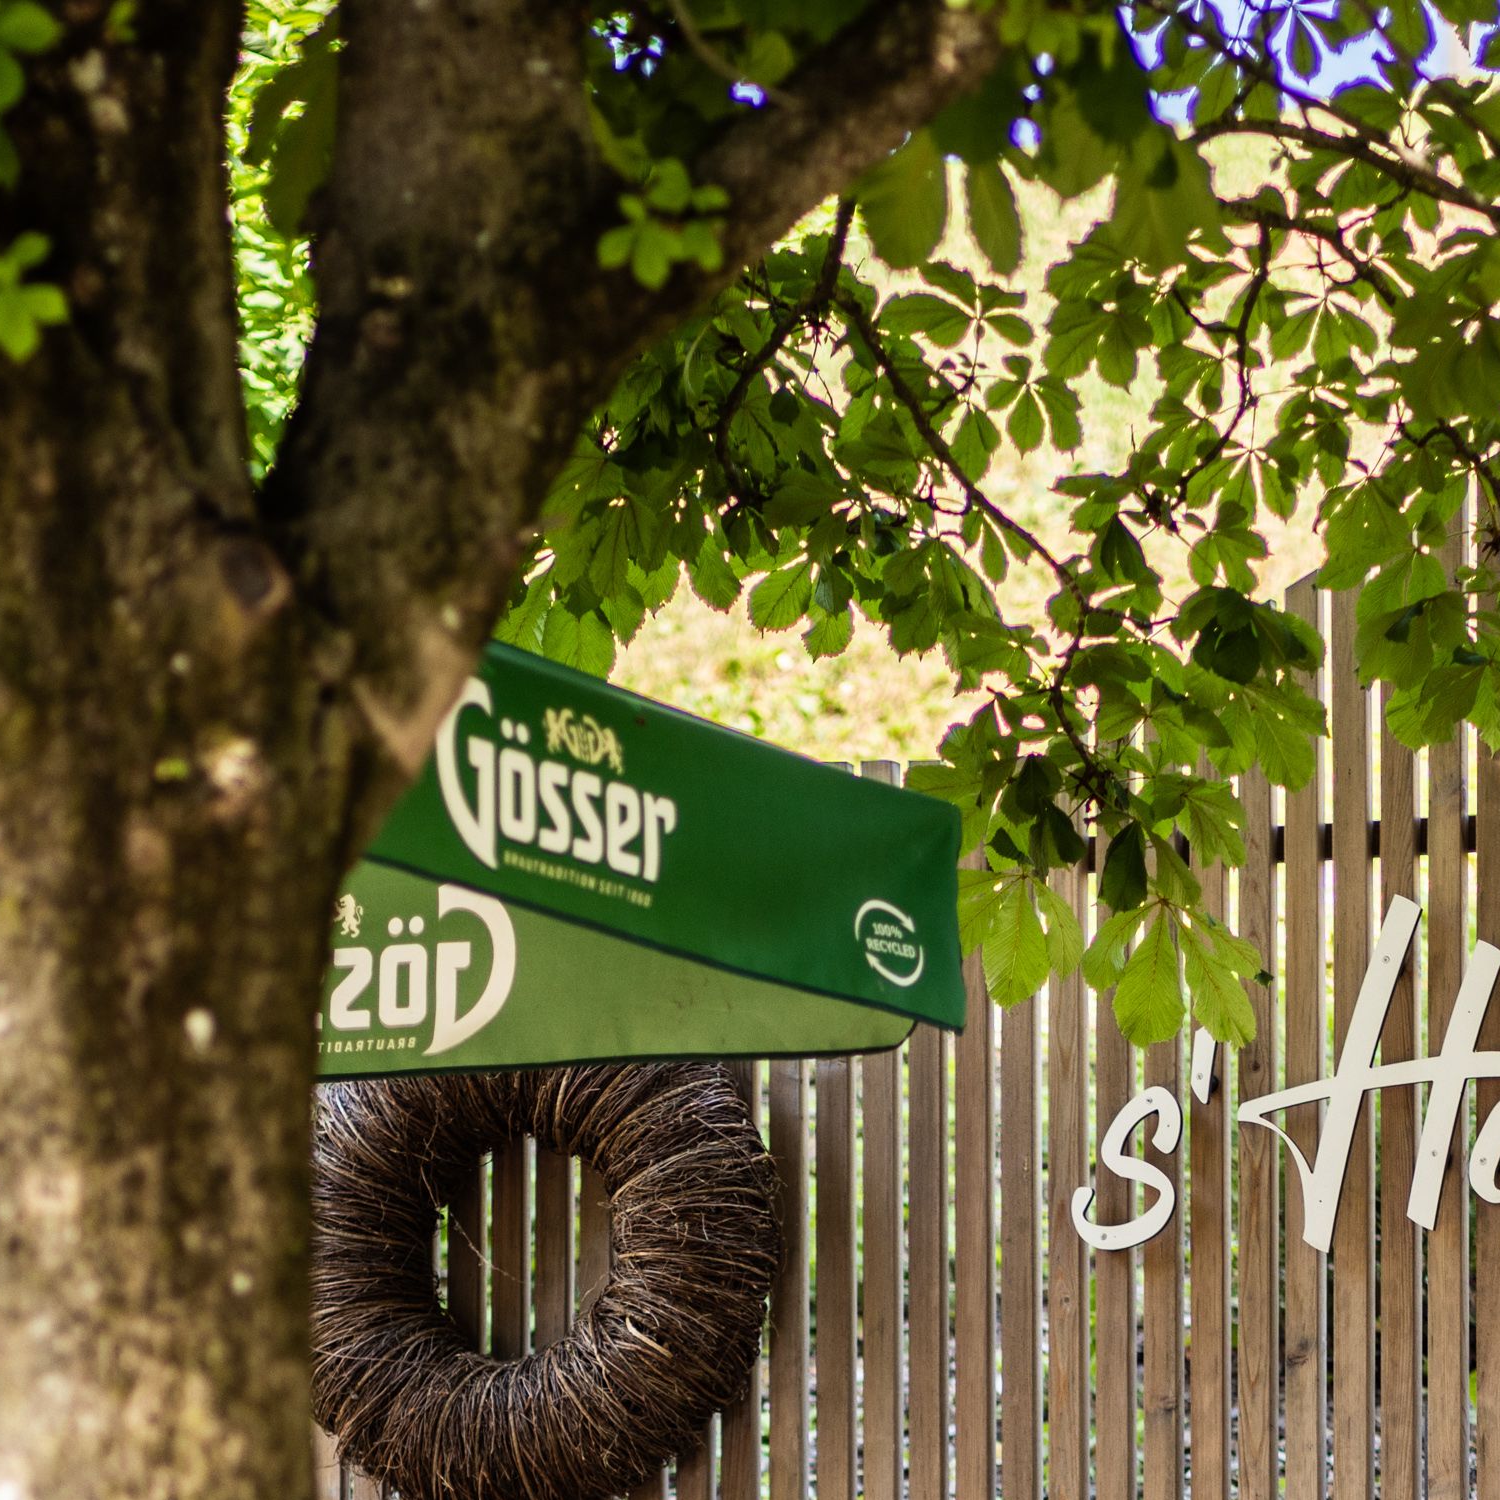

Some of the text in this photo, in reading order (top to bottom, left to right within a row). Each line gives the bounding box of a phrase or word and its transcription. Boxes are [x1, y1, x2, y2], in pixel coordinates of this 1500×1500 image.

[437, 678, 676, 882] Gösser
[873, 922, 903, 939] 100%
[866, 938, 915, 959] RECYCLED
